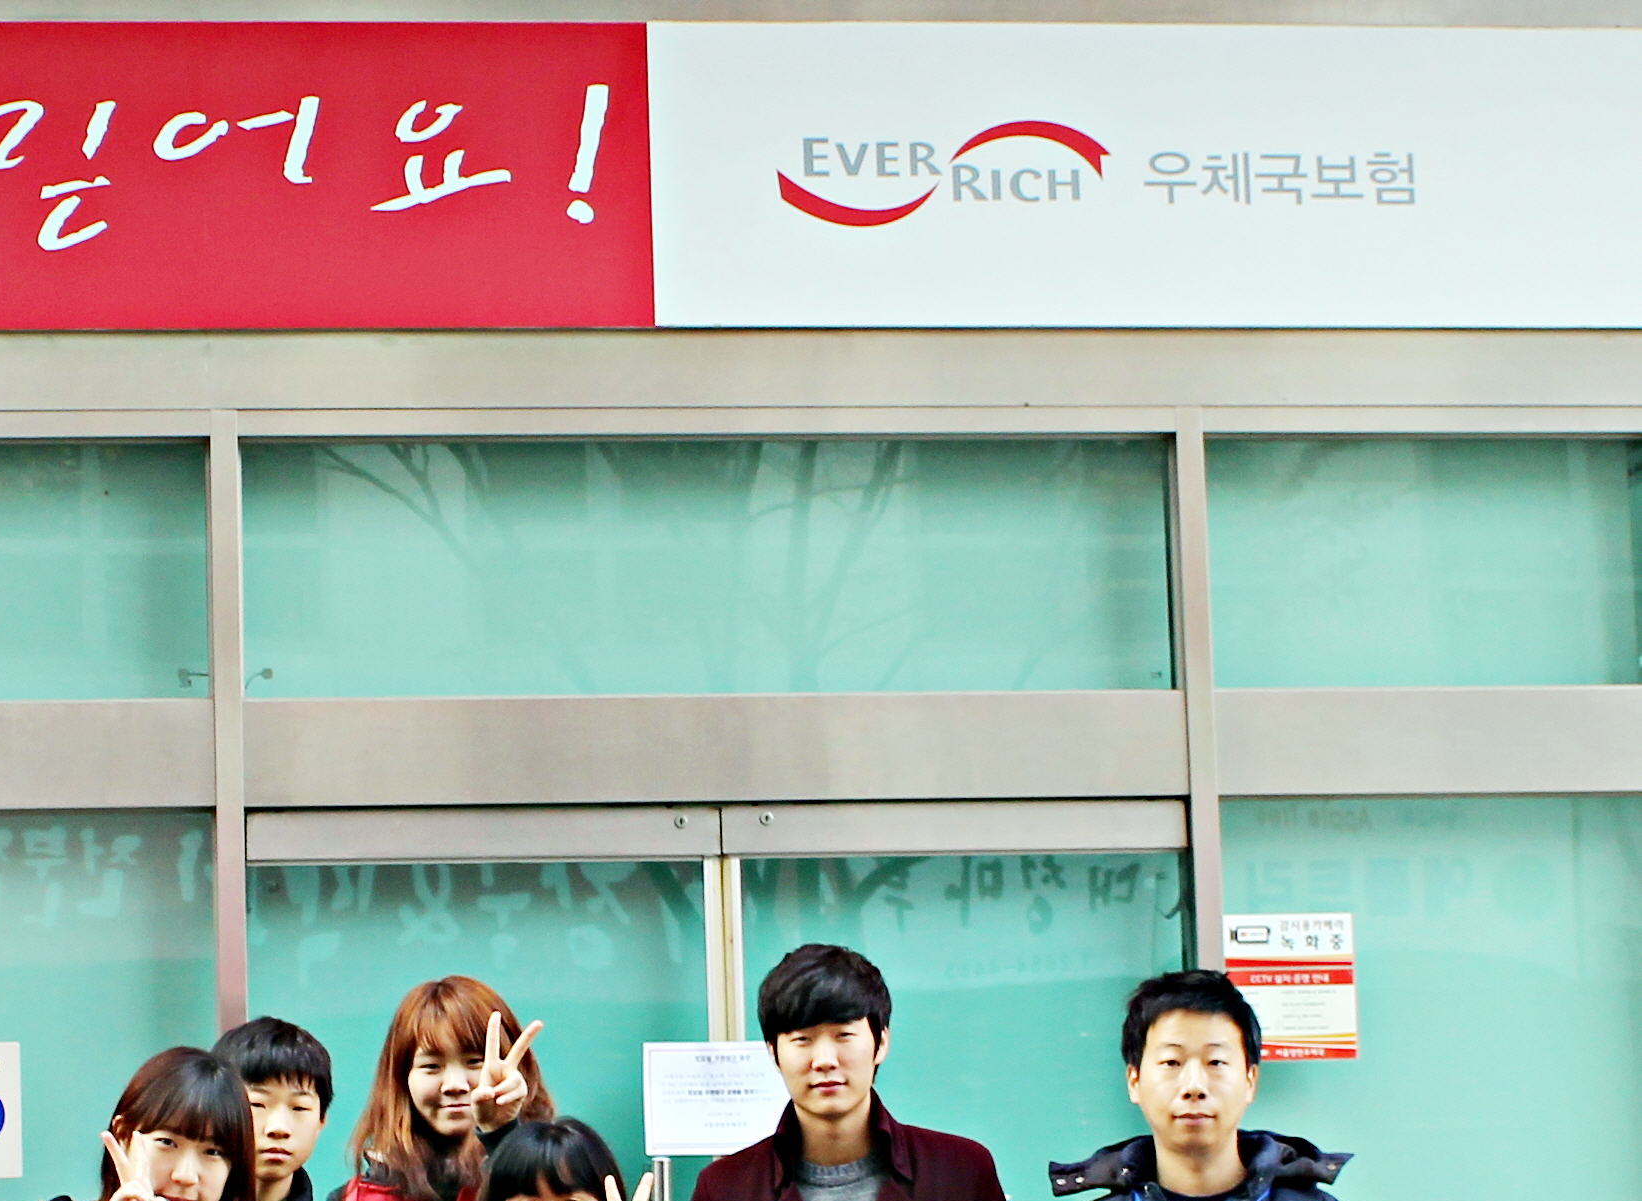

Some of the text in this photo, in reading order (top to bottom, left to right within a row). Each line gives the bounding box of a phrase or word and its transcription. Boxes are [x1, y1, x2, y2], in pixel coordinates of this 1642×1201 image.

[801, 137, 942, 177] EVER
[951, 163, 1082, 202] RICH
[1142, 150, 1417, 206] 우체국보험
